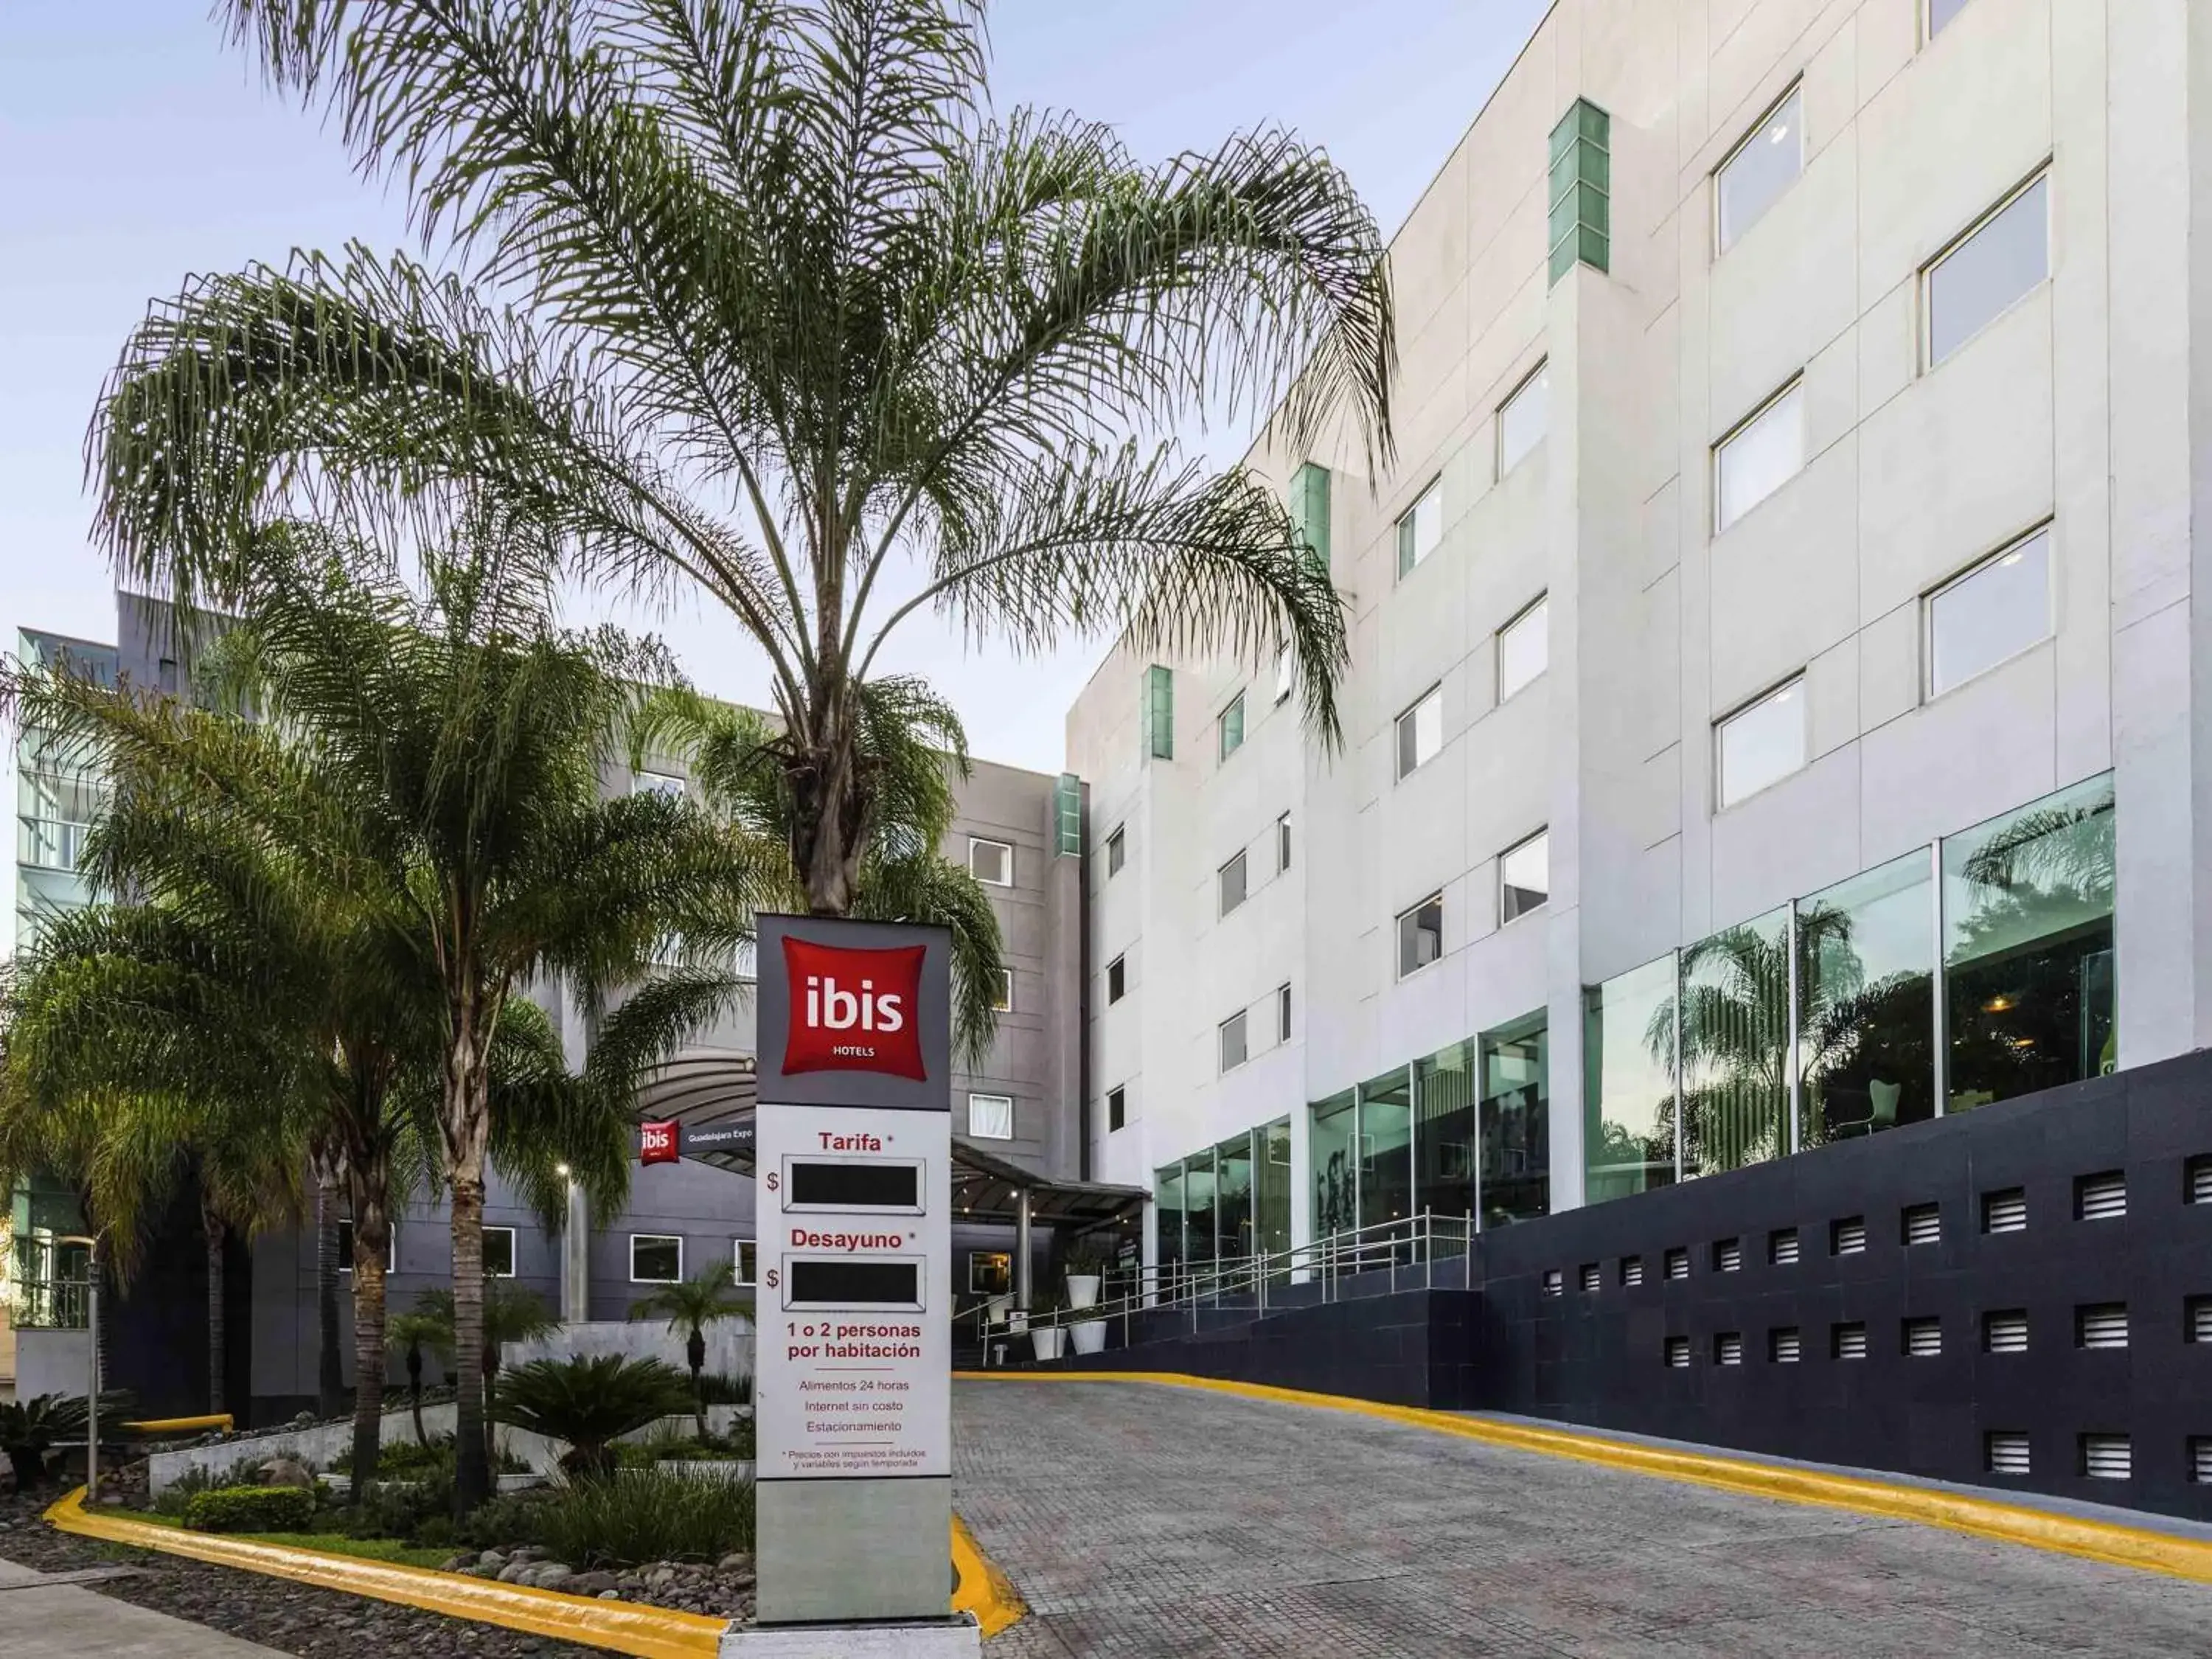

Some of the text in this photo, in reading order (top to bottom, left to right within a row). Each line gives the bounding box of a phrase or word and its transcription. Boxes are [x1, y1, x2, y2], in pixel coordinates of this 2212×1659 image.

[807, 975, 903, 1032] ibis
[833, 1046, 875, 1057] HOTELS
[642, 1130, 669, 1150] ibis
[734, 1129, 752, 1140] Expo
[767, 1172, 779, 1192] $
[767, 1269, 779, 1289] $
[787, 1323, 921, 1340] 1 o 2 personas
[788, 1343, 920, 1361] por habitación
[799, 1380, 909, 1391] Alimentos 24 horas
[805, 1402, 903, 1411] Internet sin costo
[807, 1422, 902, 1433] Estacionamiento
